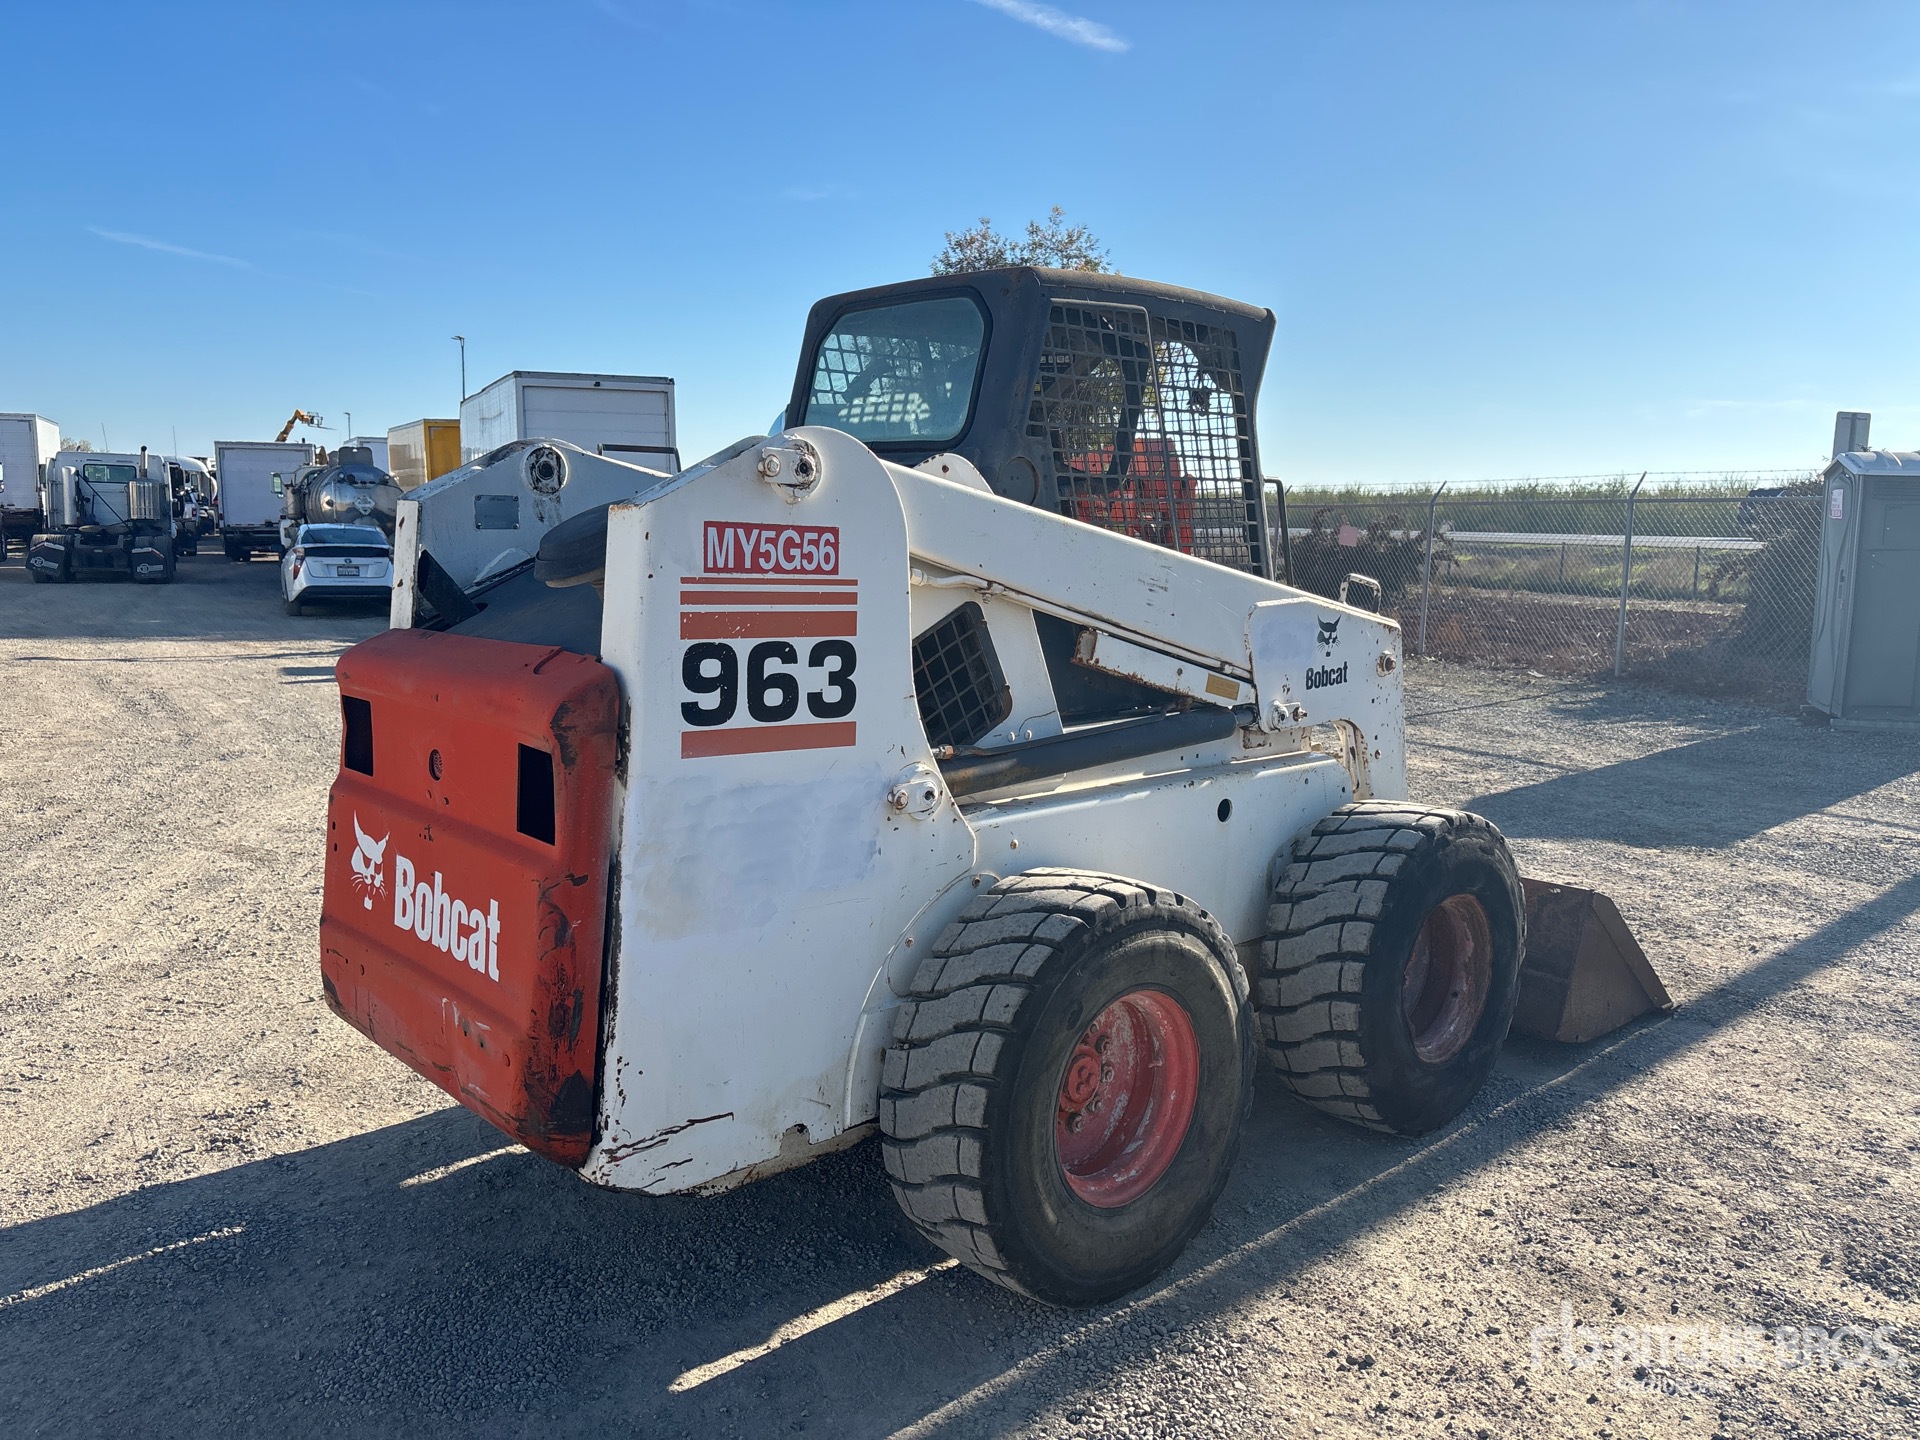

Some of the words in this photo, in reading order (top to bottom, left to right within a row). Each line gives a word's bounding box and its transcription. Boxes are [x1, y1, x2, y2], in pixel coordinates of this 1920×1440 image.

[707, 527, 836, 571] MY5G56
[681, 639, 858, 726] 963
[1305, 661, 1348, 690] Bobcat
[394, 854, 500, 982] Bobcat
